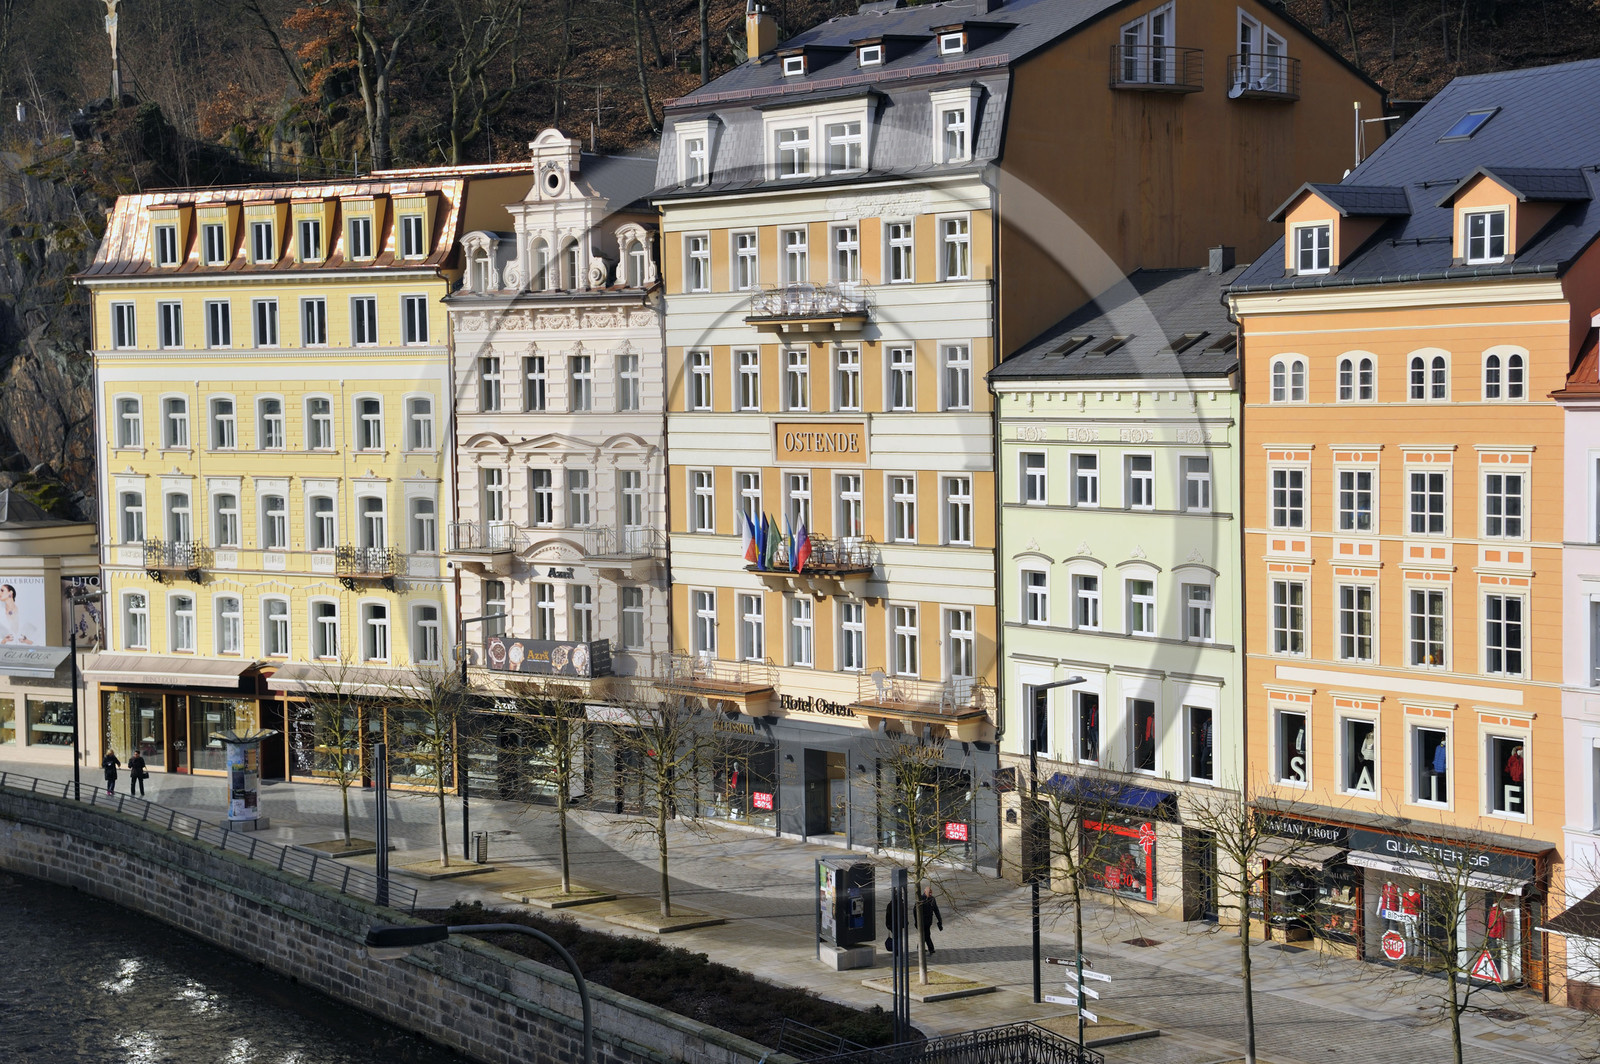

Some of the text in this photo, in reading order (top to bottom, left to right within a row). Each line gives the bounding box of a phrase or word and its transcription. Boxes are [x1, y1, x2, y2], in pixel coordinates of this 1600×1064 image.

[784, 431, 859, 453] OSTENDE
[4, 650, 51, 660] GLAMOUR
[780, 694, 815, 713] Hotel
[1384, 938, 1403, 953] STOP
